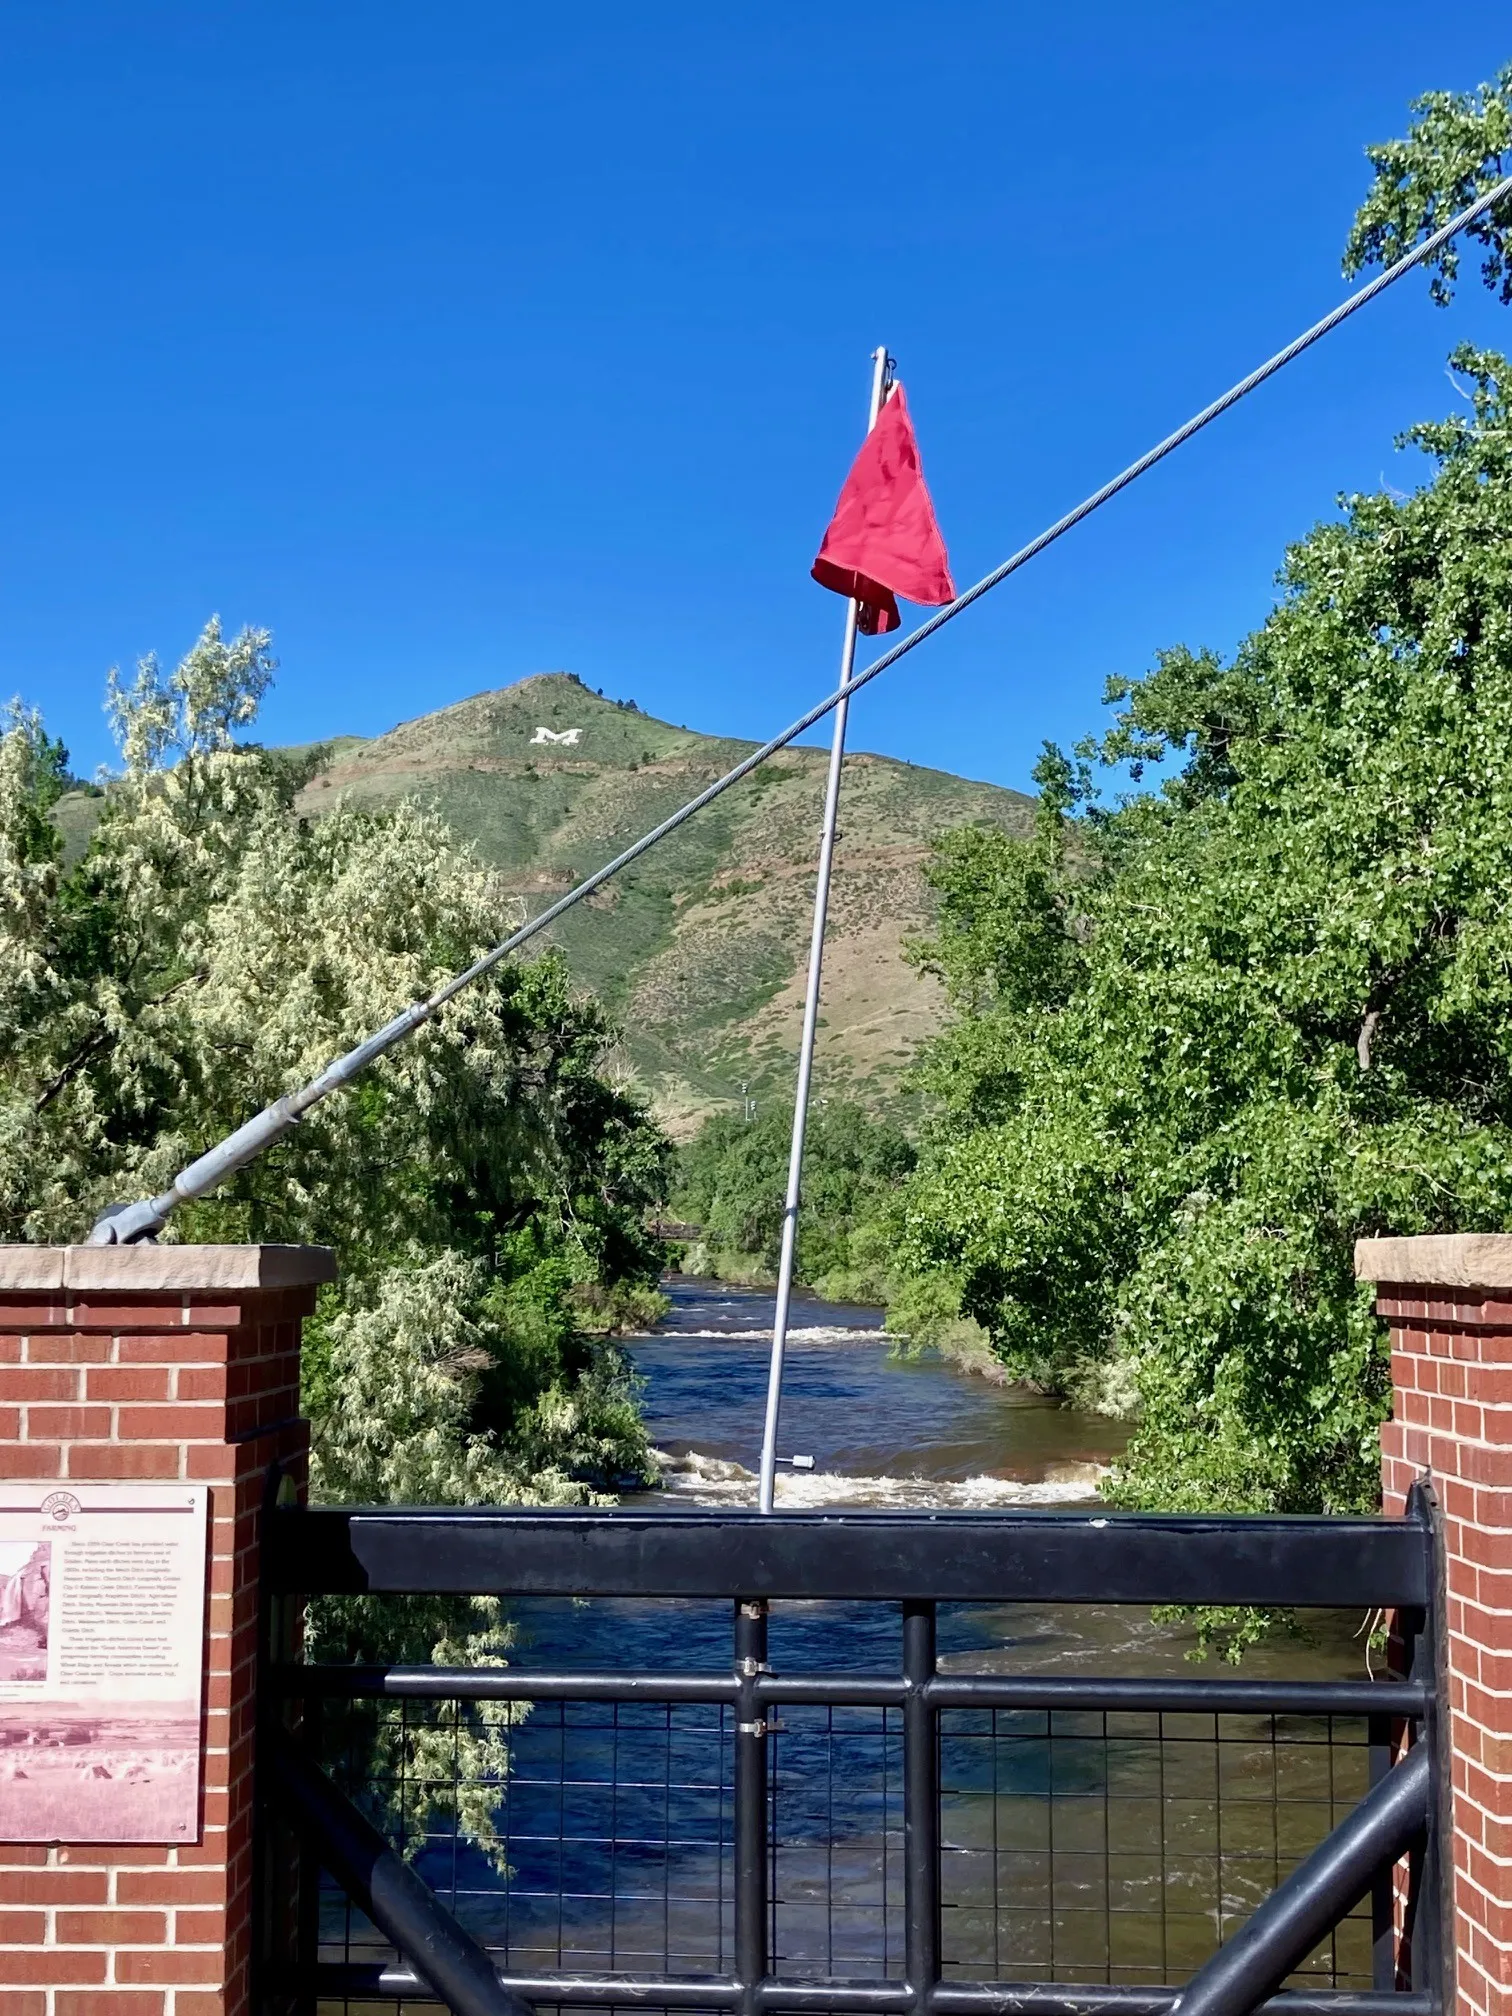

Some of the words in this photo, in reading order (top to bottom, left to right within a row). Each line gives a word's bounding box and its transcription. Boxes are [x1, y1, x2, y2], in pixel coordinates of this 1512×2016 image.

[529, 726, 583, 746] M
[42, 1493, 81, 1512] GOLDEN
[42, 1524, 77, 1532] FARMING
